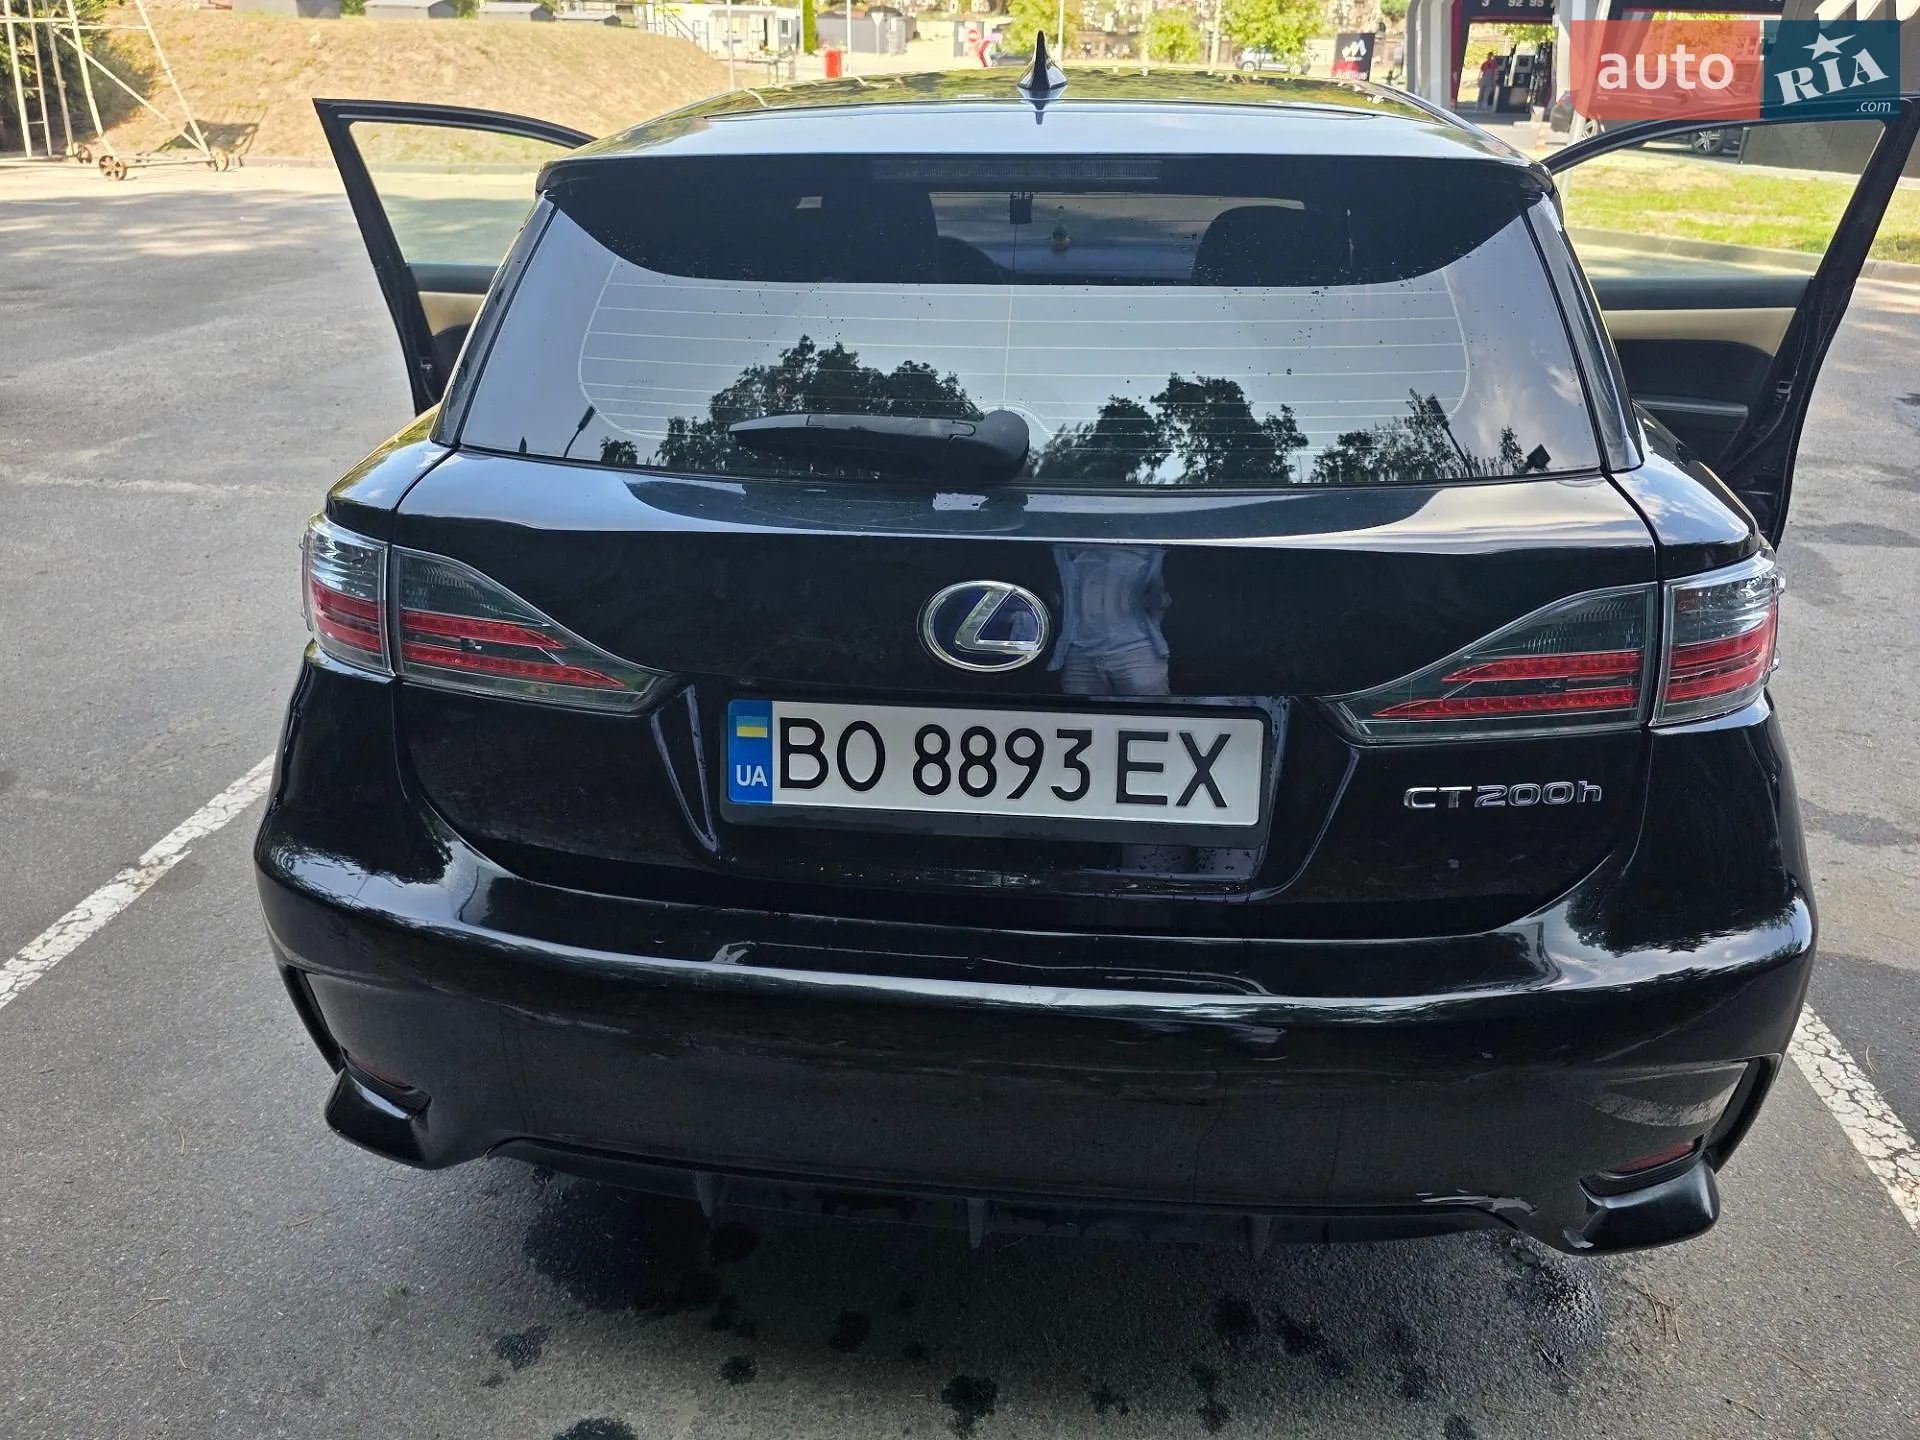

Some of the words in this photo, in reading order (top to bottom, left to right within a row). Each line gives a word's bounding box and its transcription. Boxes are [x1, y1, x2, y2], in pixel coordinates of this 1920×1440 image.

[735, 764, 769, 788] UA
[778, 717, 887, 793] BO
[911, 724, 1093, 802] 8893
[1115, 730, 1232, 809] EX
